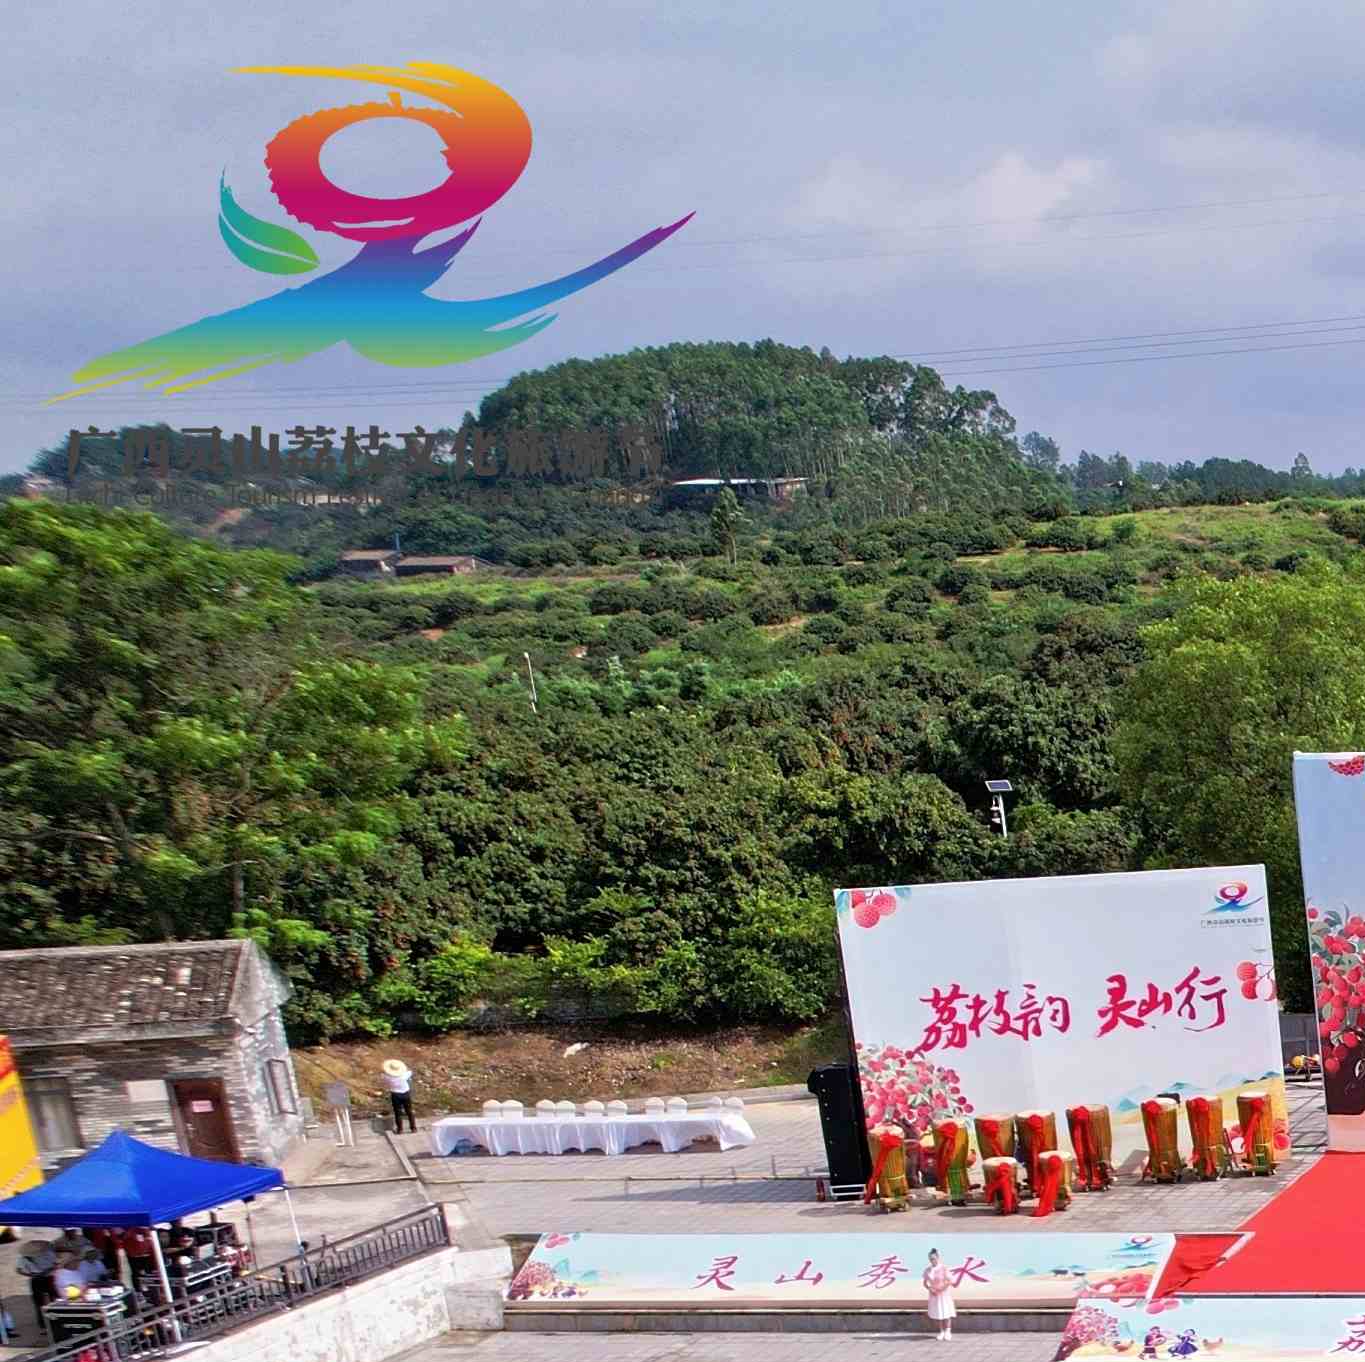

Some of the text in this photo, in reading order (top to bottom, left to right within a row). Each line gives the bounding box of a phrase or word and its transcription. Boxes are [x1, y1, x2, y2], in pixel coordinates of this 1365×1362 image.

[910, 966, 1229, 1055] 荔枝韵 灵山行
